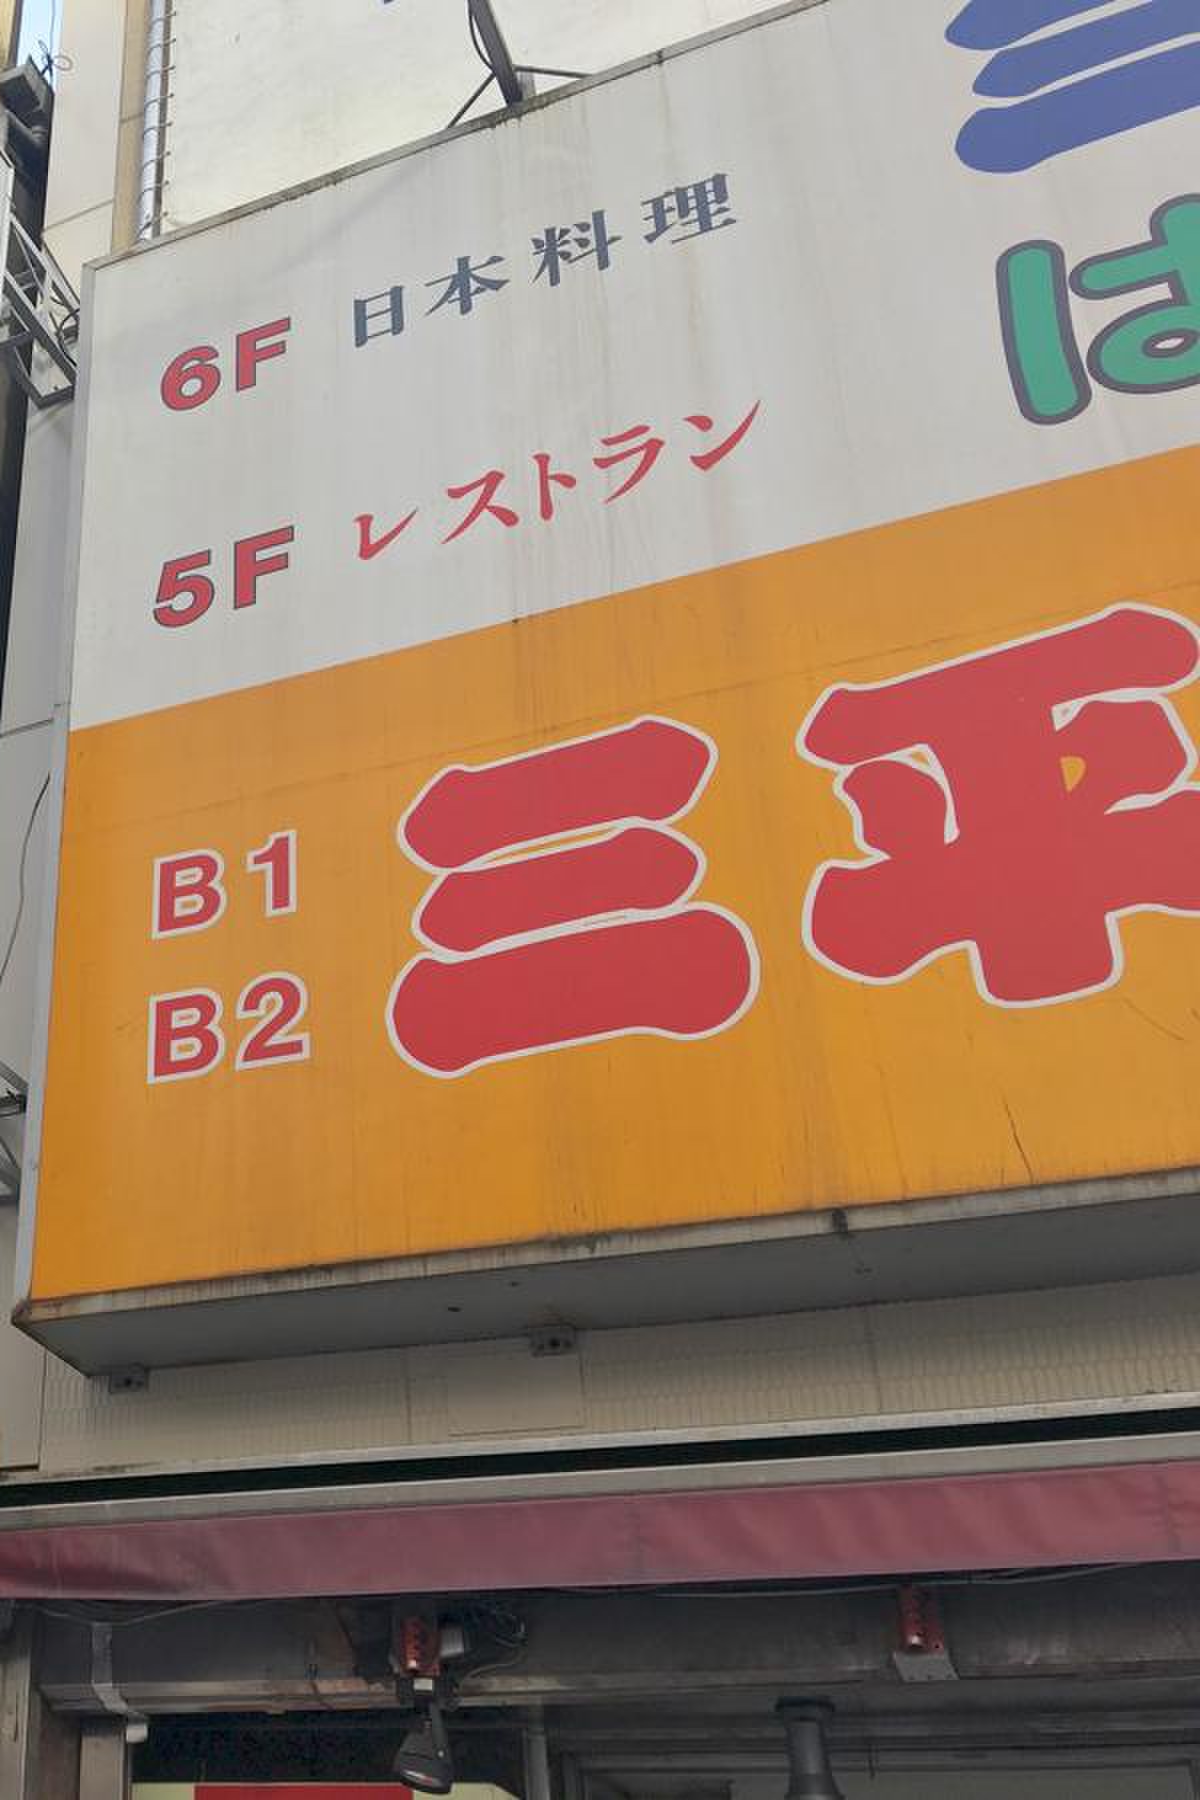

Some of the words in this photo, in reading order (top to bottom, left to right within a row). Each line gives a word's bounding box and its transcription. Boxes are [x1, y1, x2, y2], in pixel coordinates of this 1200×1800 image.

[160, 317, 292, 412] 6F
[352, 172, 738, 349] 日本料理
[152, 526, 295, 629] 5F
[353, 399, 762, 562] レストラン
[150, 829, 298, 940] B1
[385, 600, 1200, 1080] 三平
[146, 971, 311, 1085] B2
